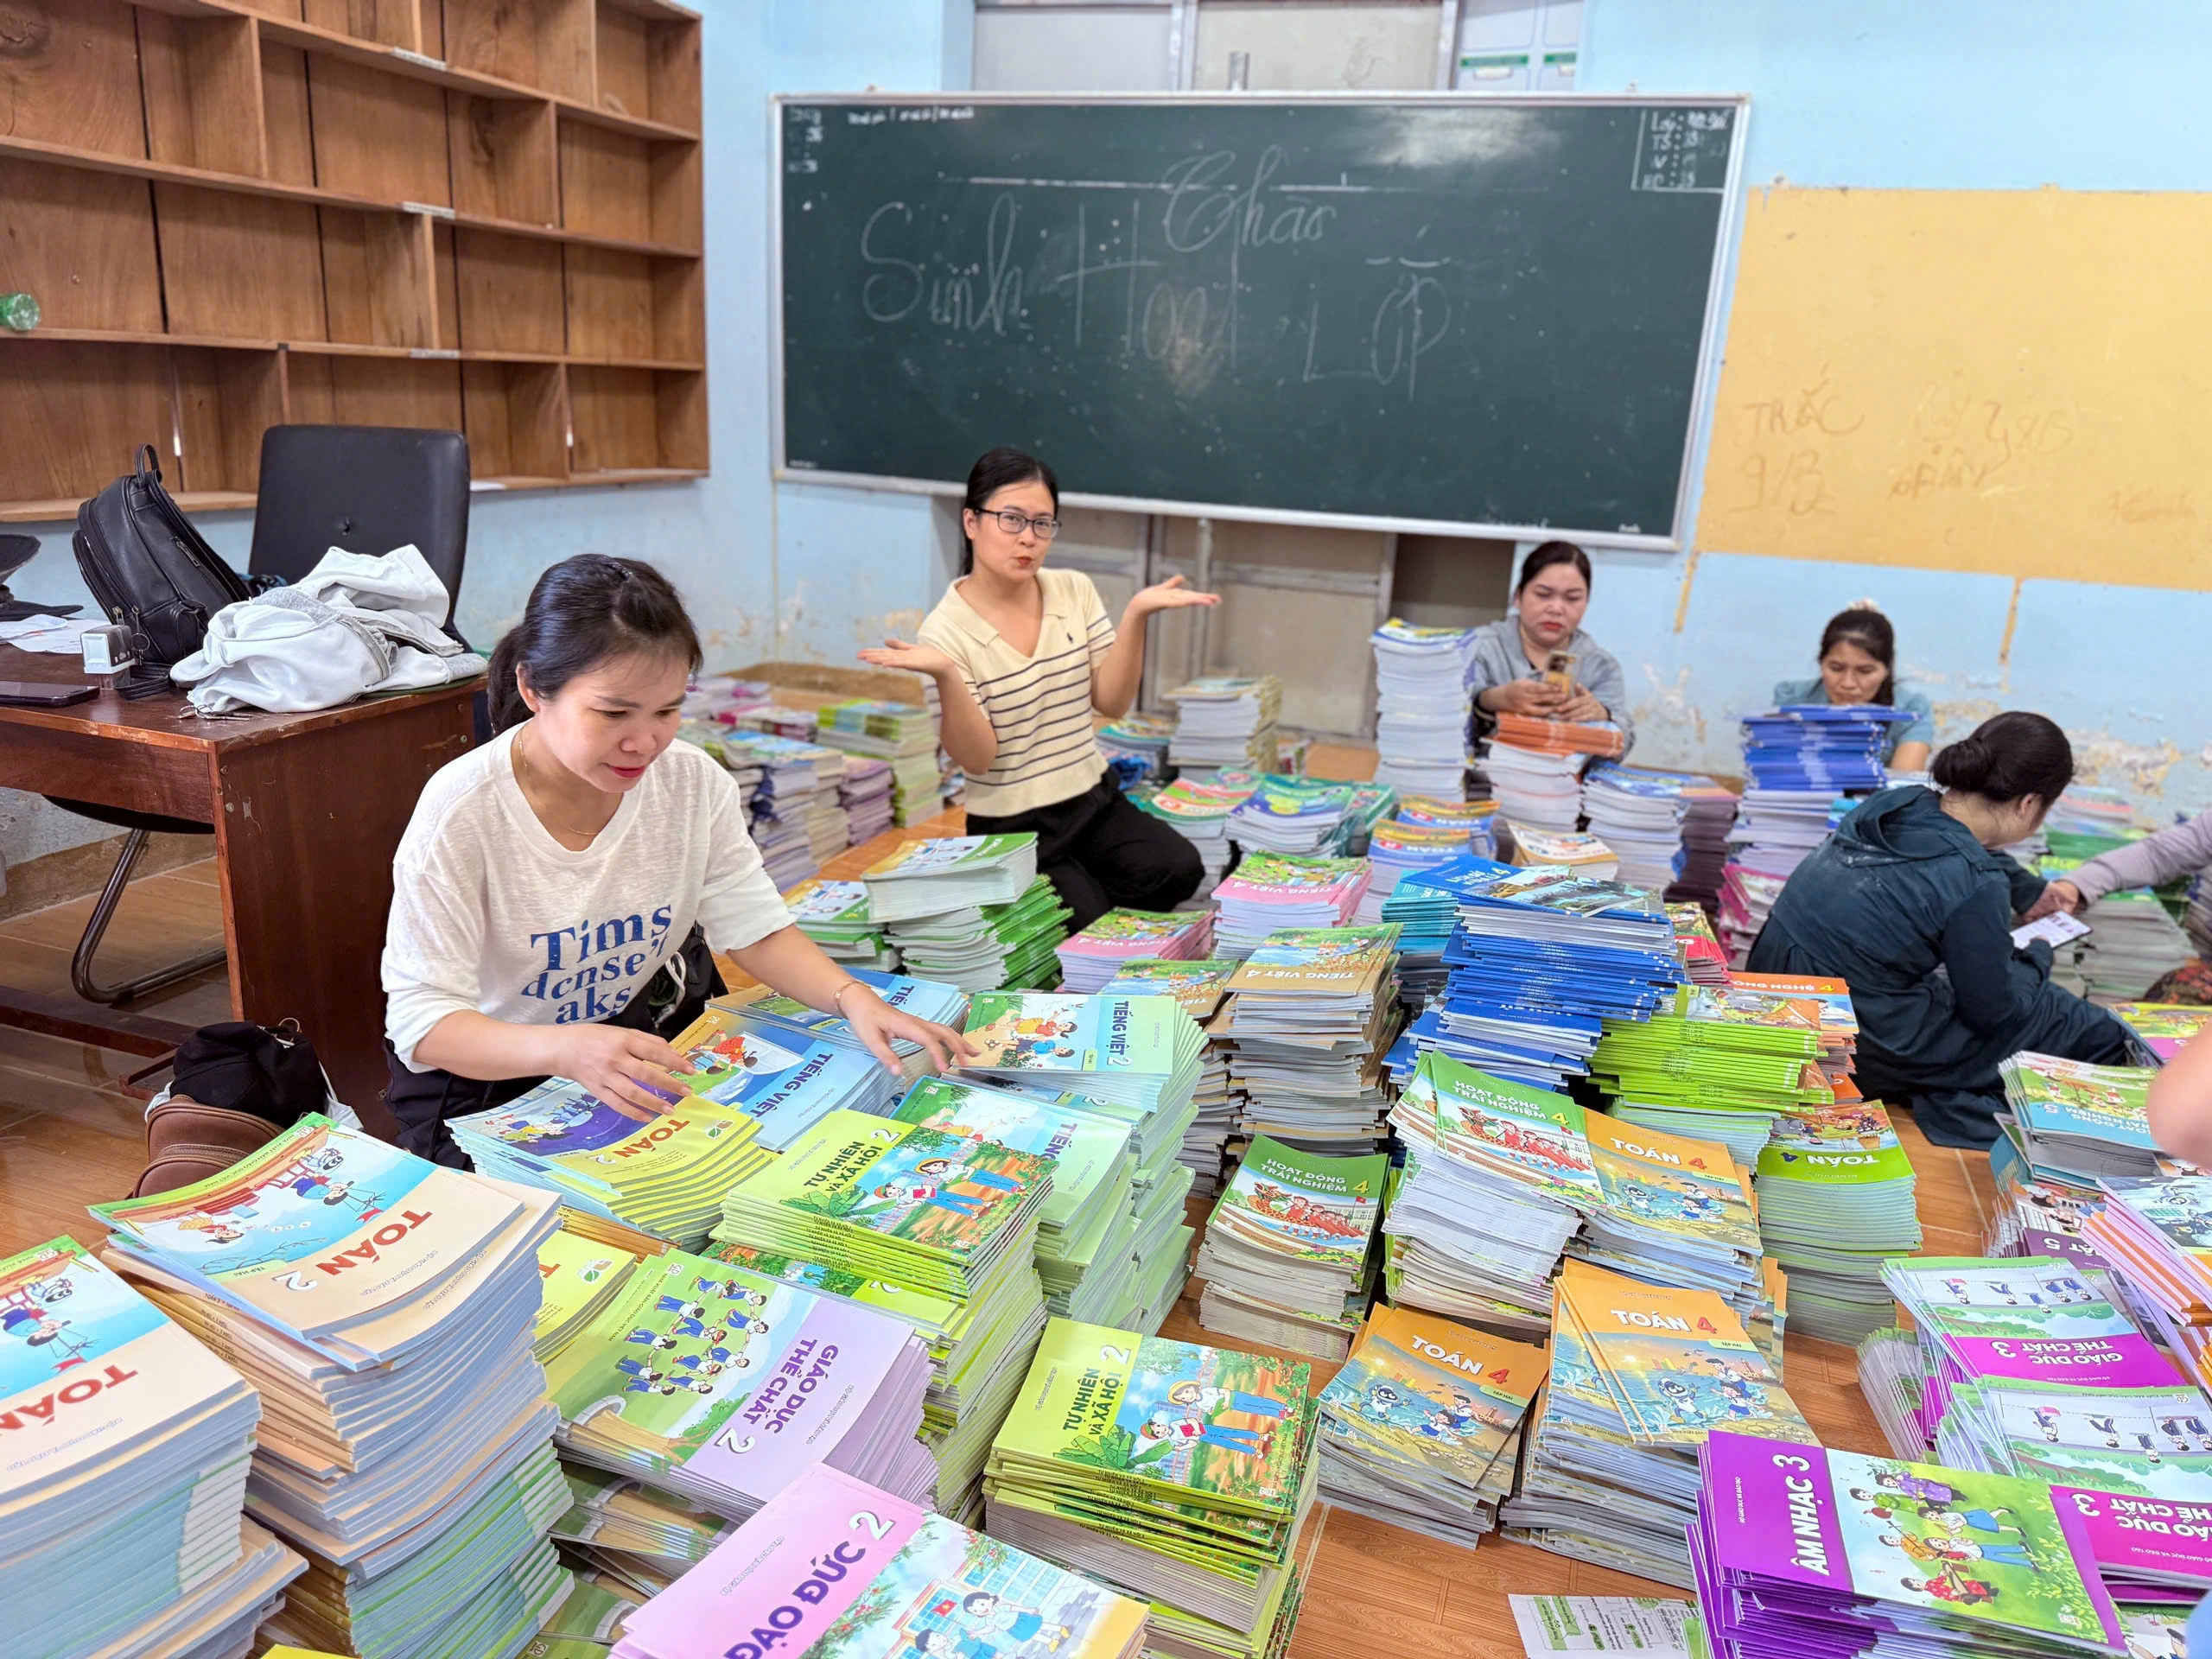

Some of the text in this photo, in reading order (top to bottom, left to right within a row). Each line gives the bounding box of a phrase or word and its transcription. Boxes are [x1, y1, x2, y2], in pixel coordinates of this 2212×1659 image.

[531, 905, 671, 971] Tims
[1246, 969, 1262, 979] 4
[1819, 983, 1835, 993] 4
[1106, 1001, 1134, 1056] TIẾNG VIỆT
[784, 1052, 835, 1091] TIẾNG
[1107, 1057, 1134, 1067] 2
[749, 1092, 787, 1118] VIỆT
[1551, 1112, 1571, 1126] 4
[613, 1119, 690, 1159] TOÁN
[870, 1127, 902, 1143] 2
[821, 1141, 866, 1175] NHIÊN
[1611, 1137, 1708, 1171] TOÁN 4
[1780, 1151, 1799, 1163] 4
[1806, 1154, 1880, 1167] TOÁN
[825, 1180, 845, 1193] VÀ
[854, 1146, 883, 1168] HỘI
[1261, 1164, 1349, 1193] TRẢI NGHIỆM
[1267, 1158, 1346, 1185] HOẠT ĐỘNG
[1352, 1179, 1370, 1194] 4
[315, 1211, 433, 1276] TOÁN
[2043, 1237, 2061, 1250] 5
[271, 1270, 319, 1292] 2
[1611, 1310, 1718, 1334] TOÁN 4
[1099, 1344, 1132, 1365] 2
[1412, 1335, 1510, 1385] TOÁN 4
[1991, 1341, 2018, 1359] 3
[2022, 1340, 2114, 1354] THỂ CHẤT
[2028, 1352, 2124, 1366] GIÁO DỤC
[742, 1338, 818, 1425] THỂ CHẤT
[765, 1344, 840, 1434] GIÁO DỤC
[1062, 1368, 1101, 1431] TỰ NHIÊN
[1089, 1372, 1124, 1435] VÀ XÃ HỘI
[716, 1427, 756, 1454] 2
[1772, 1454, 1811, 1471] 3
[2071, 1493, 2101, 1517] 3
[2109, 1497, 2212, 1523] HỂ CHẤT
[849, 1510, 896, 1541] 2
[1785, 1475, 1831, 1576] ÂM NHẠC
[2115, 1514, 2172, 1535] DỤC
[723, 1541, 866, 1659] ĐẠO ĐỨC
